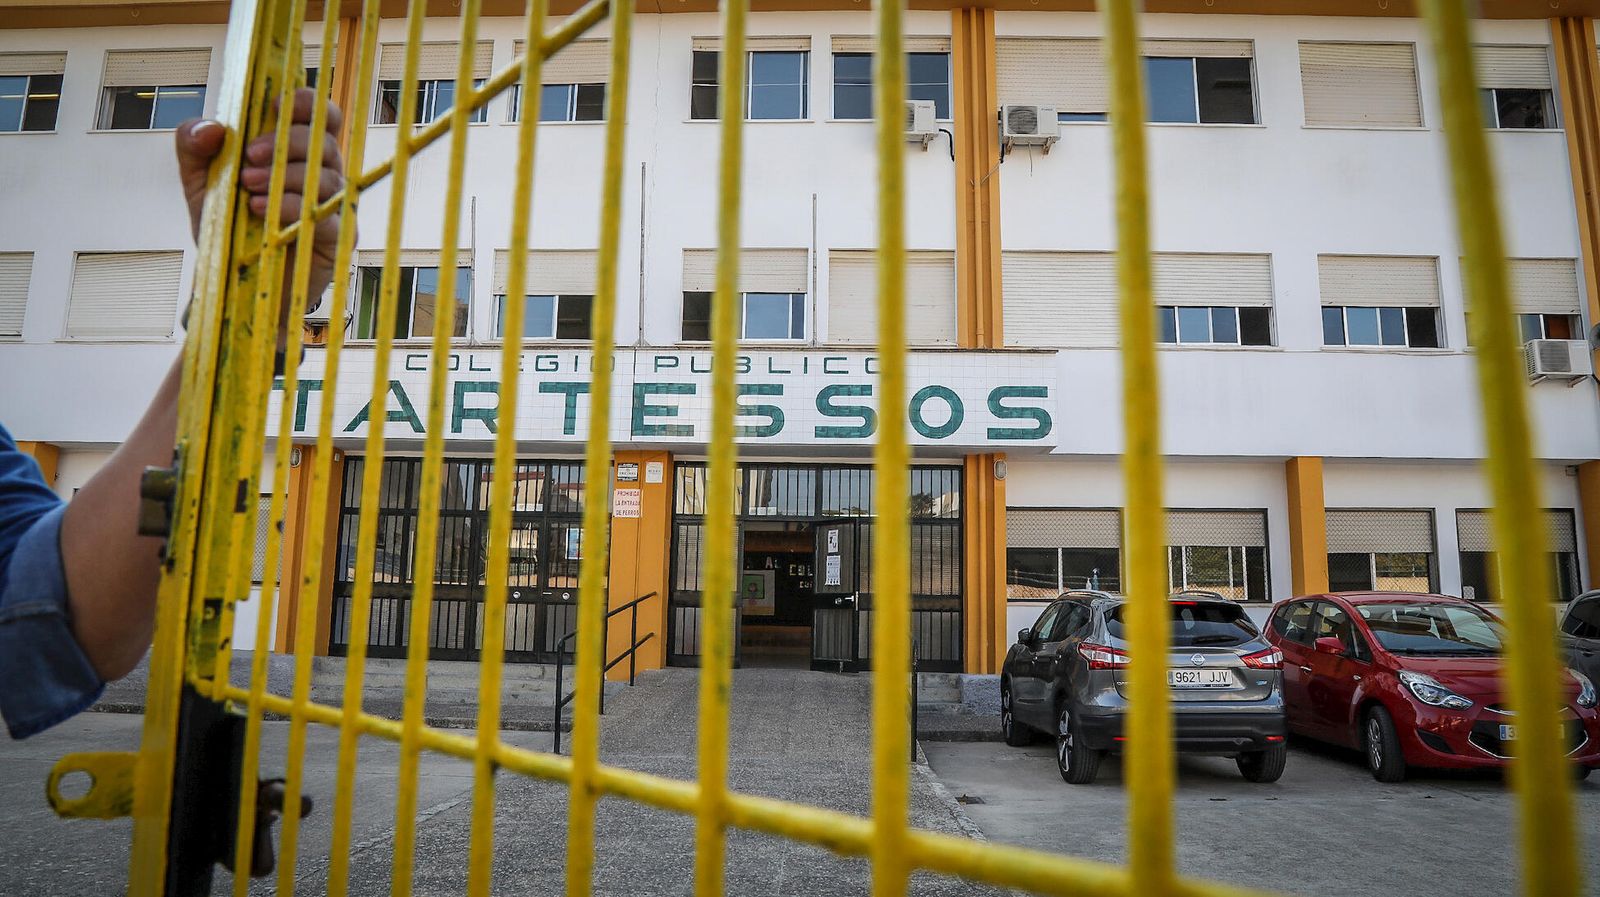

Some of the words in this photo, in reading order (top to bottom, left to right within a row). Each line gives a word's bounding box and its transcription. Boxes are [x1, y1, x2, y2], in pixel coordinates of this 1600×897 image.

[654, 356, 881, 374] PUBLICO
[271, 380, 1052, 439] TARTESSOS
[1175, 671, 1201, 683] 9621
[1209, 671, 1228, 683] JJV
